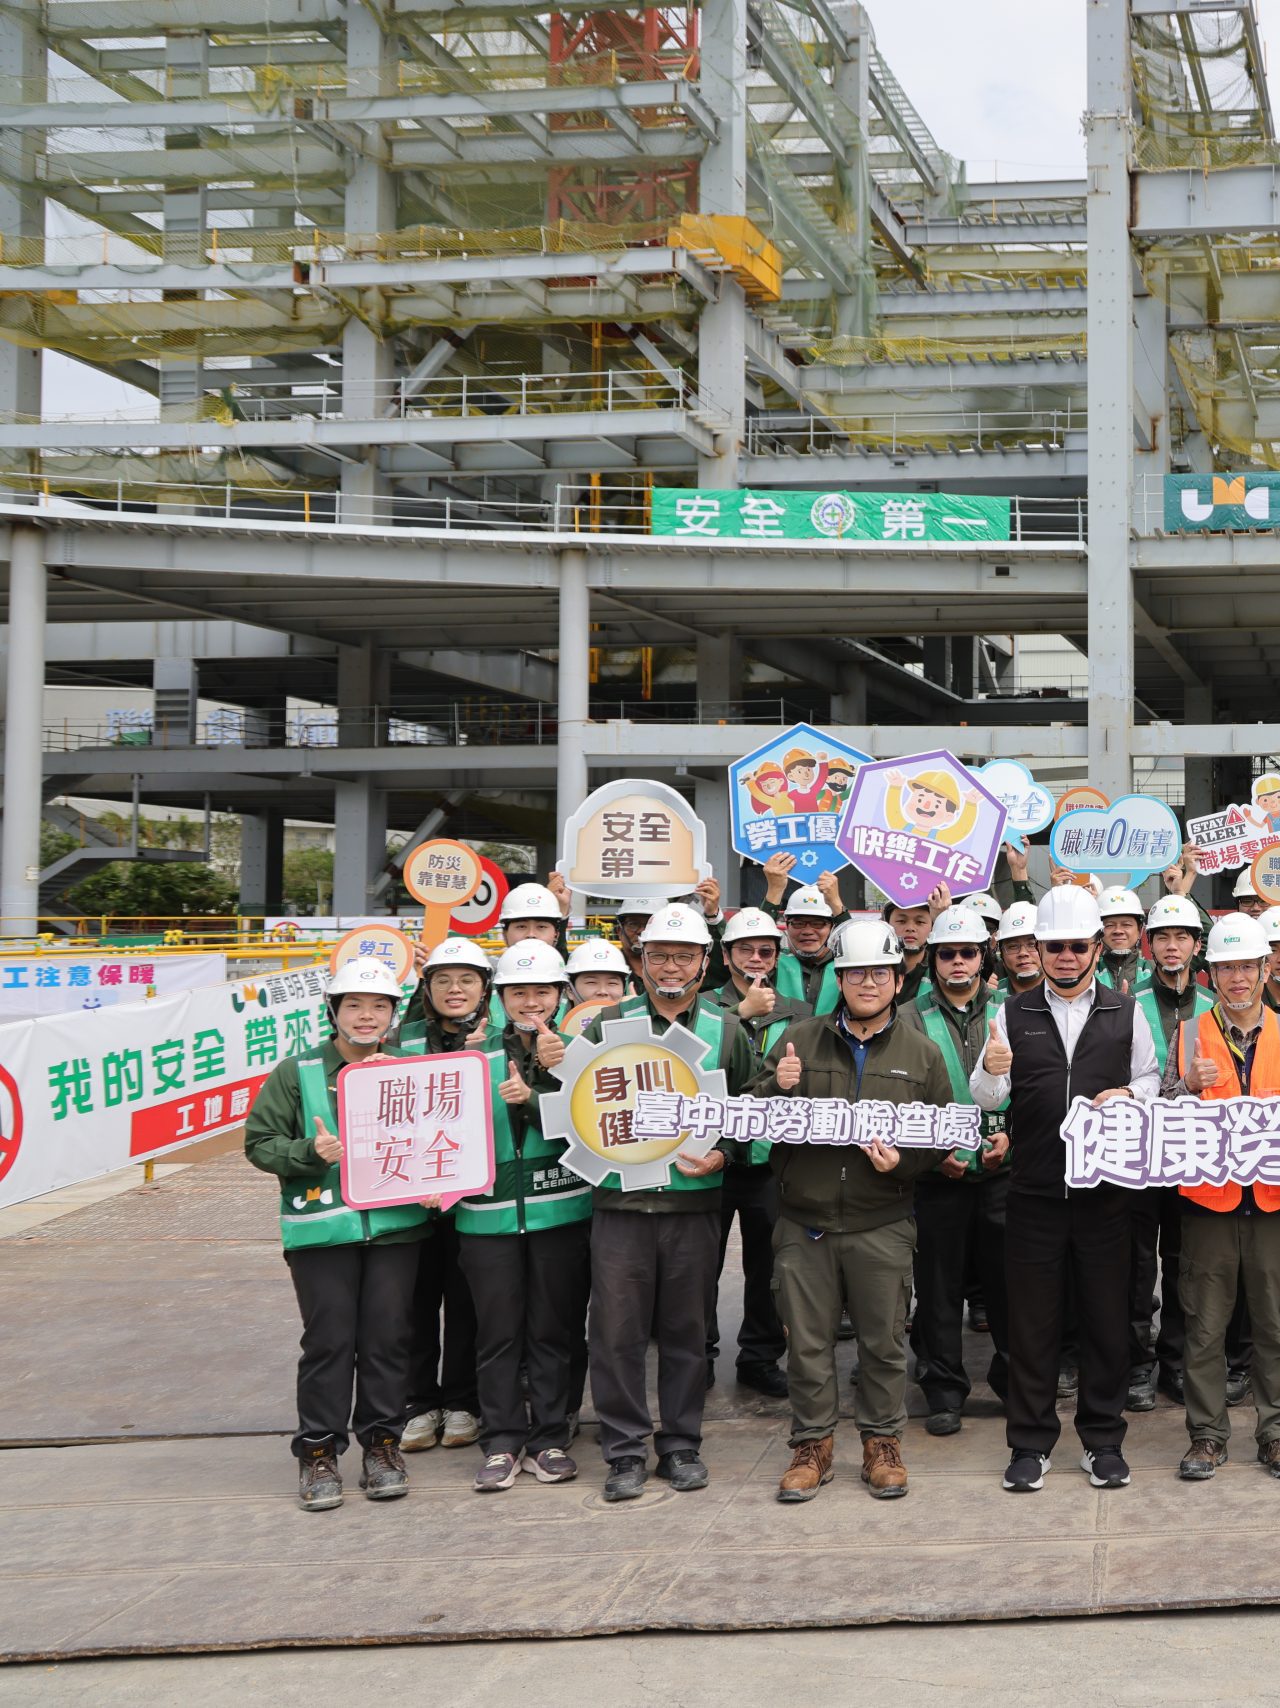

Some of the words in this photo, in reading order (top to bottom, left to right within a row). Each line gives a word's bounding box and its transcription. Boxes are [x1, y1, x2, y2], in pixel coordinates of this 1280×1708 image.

[675, 495, 786, 538] 安全
[880, 498, 988, 540] 第一
[602, 812, 672, 843] 安全
[745, 815, 841, 851] 勞工優
[1192, 815, 1227, 833] STAY
[1195, 824, 1247, 845] ALERT
[428, 854, 462, 871] 防災
[600, 848, 671, 879] 第一
[853, 825, 982, 885] 快樂工作
[417, 872, 467, 891] 靠智慧
[359, 940, 394, 957] 勞工
[2, 964, 155, 988] 工注意保暖
[47, 1028, 227, 1121] 我的安全
[593, 1060, 675, 1103] 身心
[176, 1082, 264, 1136] 工地嚴
[375, 1071, 462, 1128] 職場
[635, 1095, 980, 1148] 臺中市勞動檢查處
[370, 1129, 462, 1190] 安全
[533, 1166, 572, 1182] 麗明營
